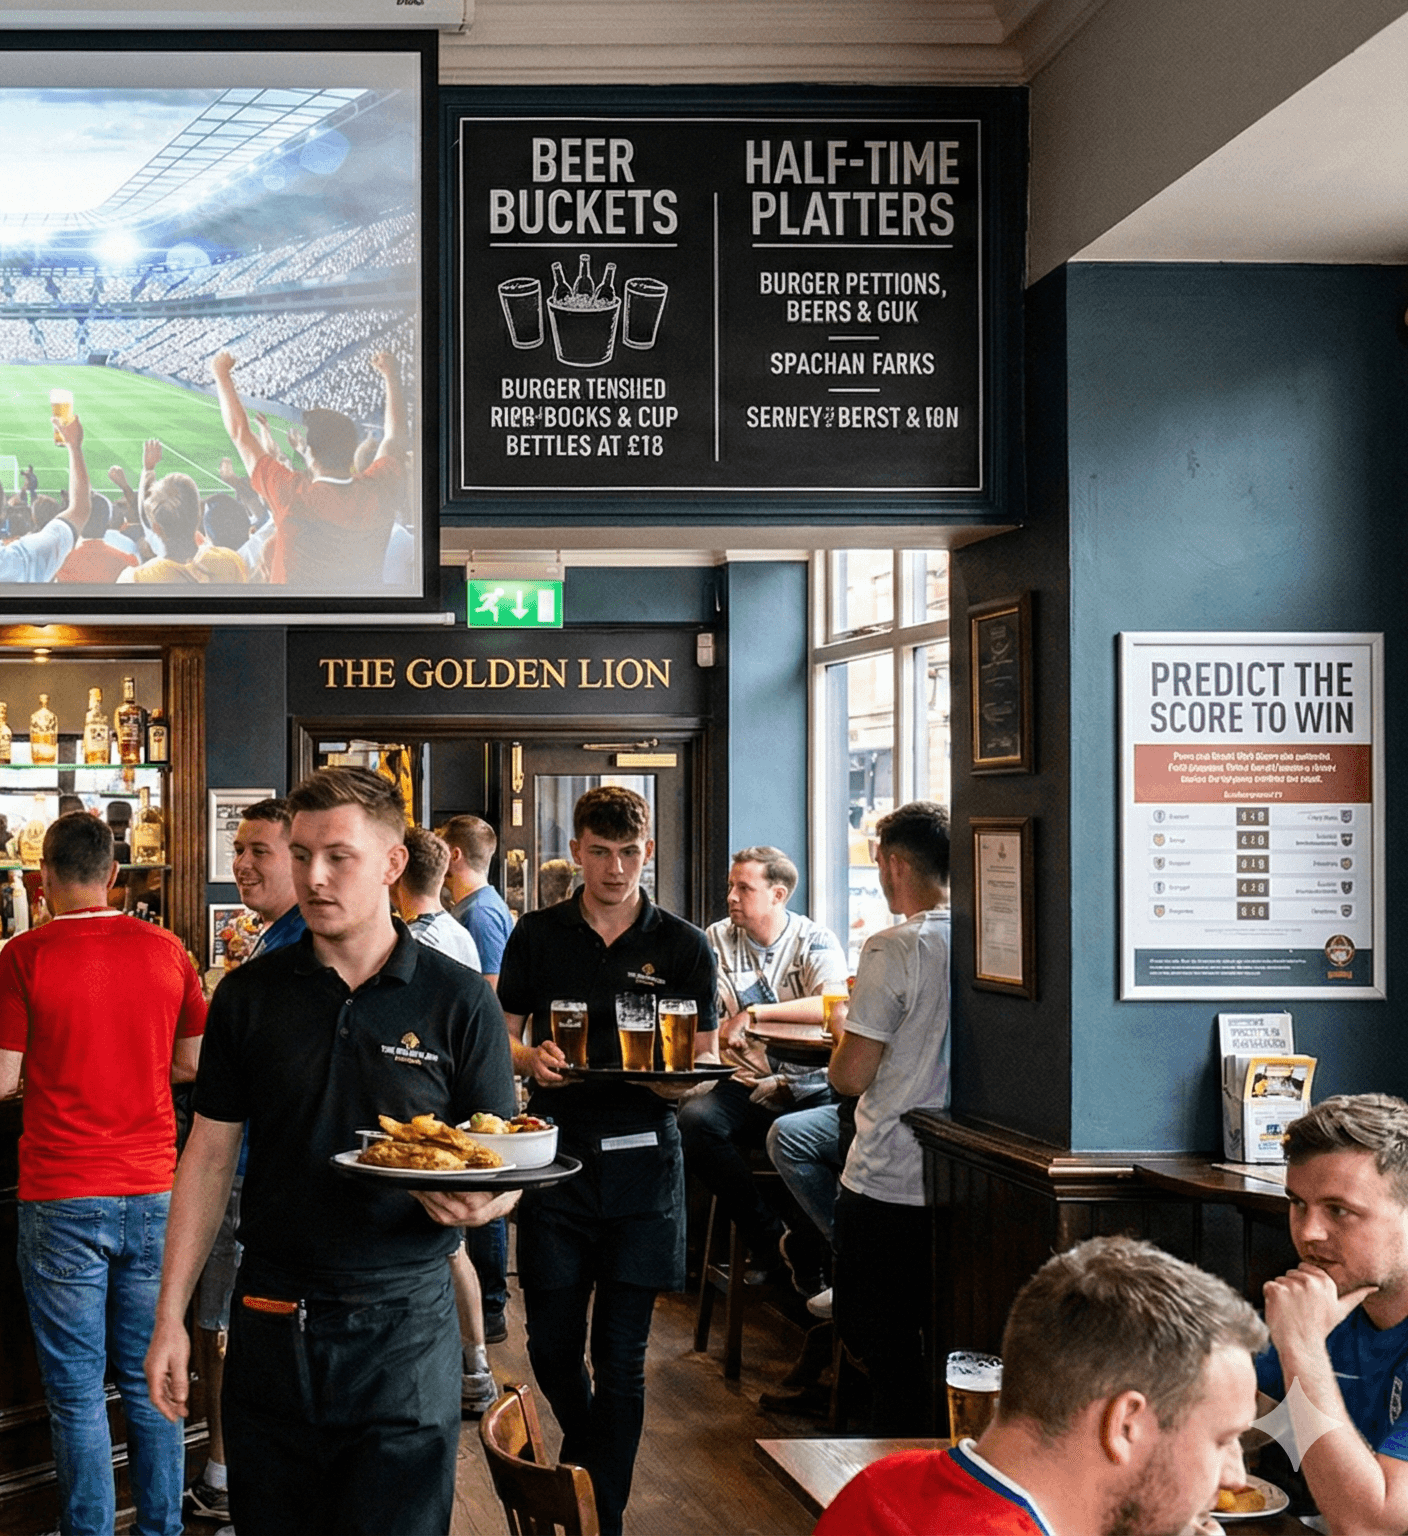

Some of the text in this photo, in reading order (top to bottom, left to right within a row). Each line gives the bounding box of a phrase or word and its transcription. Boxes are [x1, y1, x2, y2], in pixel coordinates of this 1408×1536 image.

[532, 137, 635, 183] BEER
[746, 140, 960, 185] HALF-TIME
[489, 188, 679, 236] BUCKETS
[752, 191, 955, 236] PLATTERS
[759, 271, 947, 298] BURGER PETTIONS,
[786, 300, 919, 323] BEERS & GUK
[770, 352, 935, 375] SPACHAN FARKS
[501, 377, 581, 400] BURGER
[617, 405, 632, 428] &
[638, 406, 679, 428] CUP
[838, 406, 901, 429] BERST
[905, 406, 921, 429] &
[506, 434, 664, 457] BETTLES AT £18
[319, 658, 673, 689] THE GOLDEN LION
[1151, 661, 1354, 697] PREDICT THE
[1150, 701, 1354, 733] SCORE TO WIN
